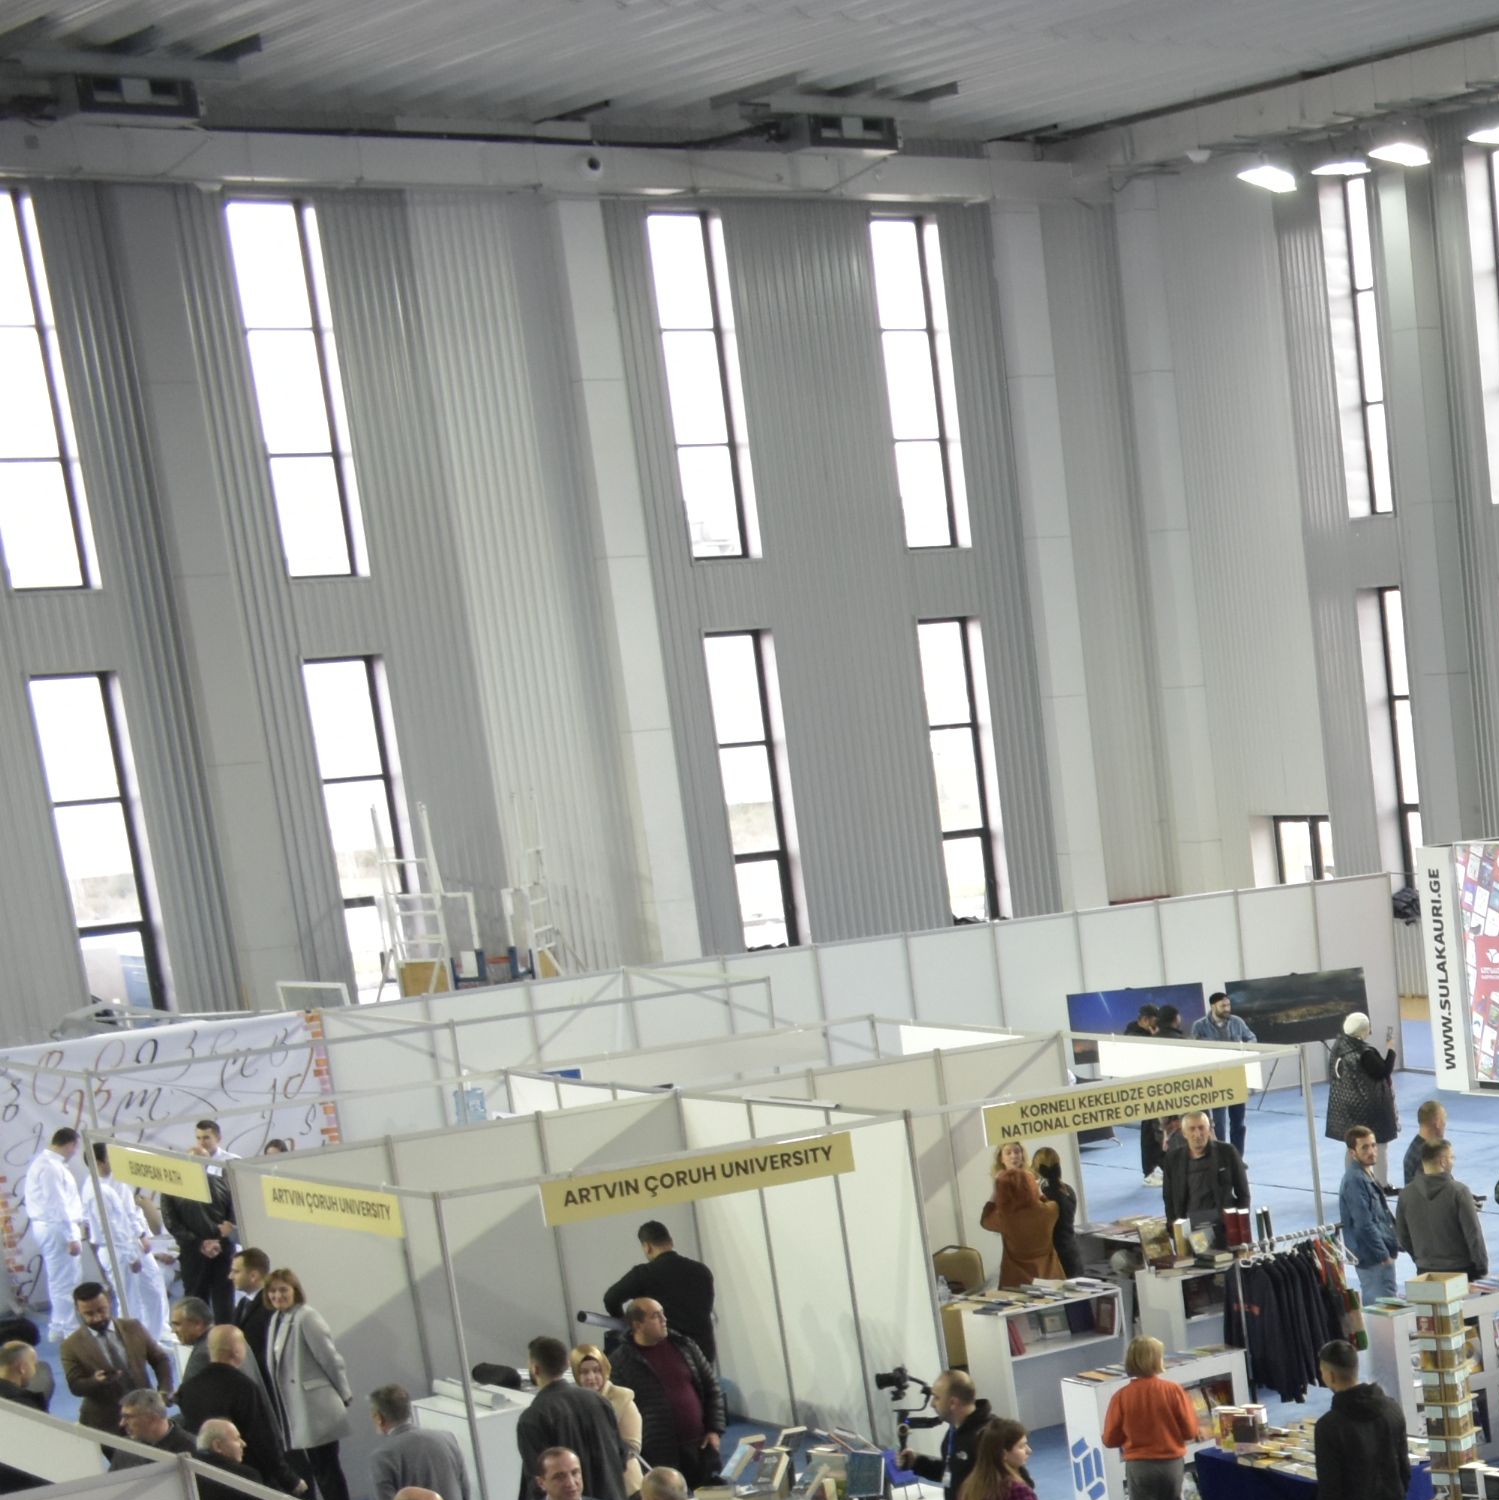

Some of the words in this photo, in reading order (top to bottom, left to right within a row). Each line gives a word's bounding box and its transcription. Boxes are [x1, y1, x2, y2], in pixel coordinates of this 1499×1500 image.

[1428, 868, 1456, 1070] WWW.SULAKAURI.GE
[1001, 1118, 1070, 1139] NATIONAL
[1072, 1106, 1121, 1127] CENTRE
[1124, 1103, 1141, 1118] OF
[1143, 1087, 1235, 1115] MANUSCRIPTS
[1020, 1098, 1076, 1119] KORNELI
[1078, 1086, 1145, 1109] KEKELIDZE
[1146, 1075, 1213, 1098] GEORGIAN
[129, 1160, 163, 1182] EUROPEAN
[164, 1168, 183, 1187] PATH
[563, 1178, 640, 1208] ARTVIN
[643, 1164, 717, 1198] ÇORUH
[720, 1145, 833, 1179] UNIVERSITY
[272, 1187, 305, 1206] ARTVIN
[306, 1193, 340, 1214] ÇORUH
[339, 1196, 392, 1221] UNIVERSITY
